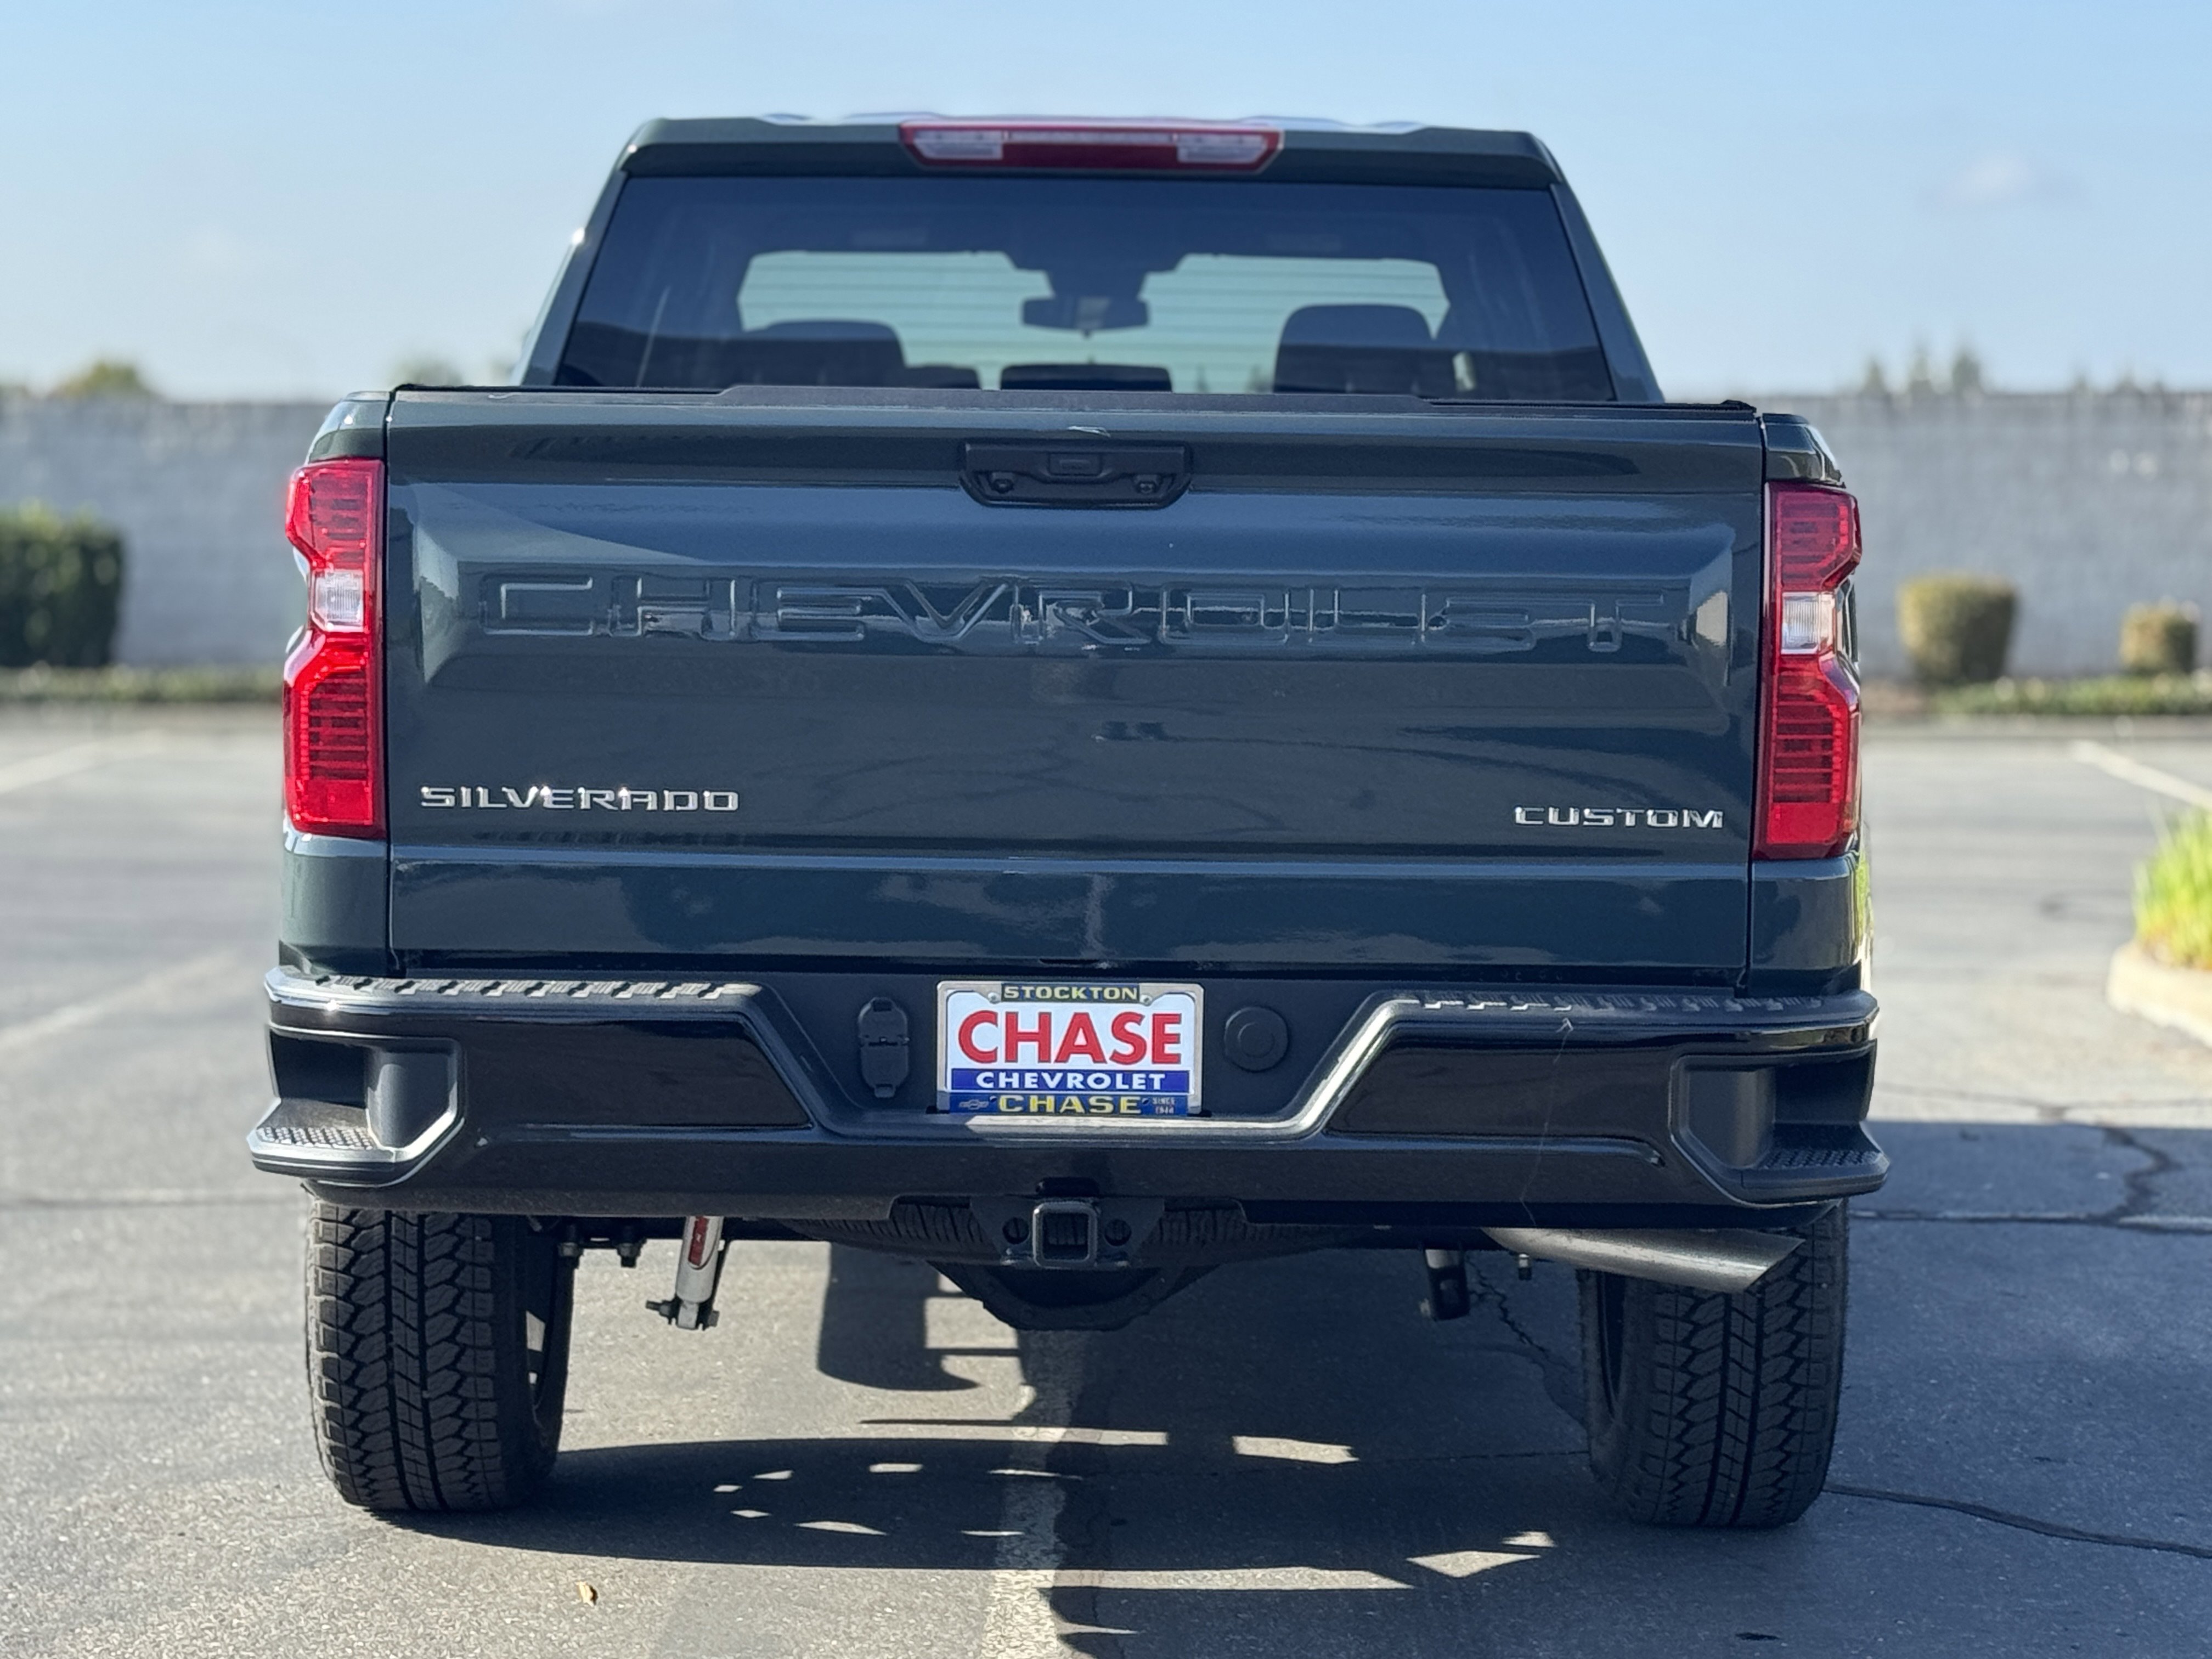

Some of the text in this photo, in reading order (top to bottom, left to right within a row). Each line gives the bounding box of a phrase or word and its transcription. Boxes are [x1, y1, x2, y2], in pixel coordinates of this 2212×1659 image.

[479, 573, 1664, 653] CHEVROLET
[421, 787, 739, 811] SILVERADO
[1515, 807, 1723, 828] CUSTOM
[1004, 987, 1138, 1001] STOCKTON
[958, 1010, 1182, 1064] CHASE
[976, 1072, 1165, 1090] CHEVROLET
[999, 1096, 1141, 1115] CHASE
